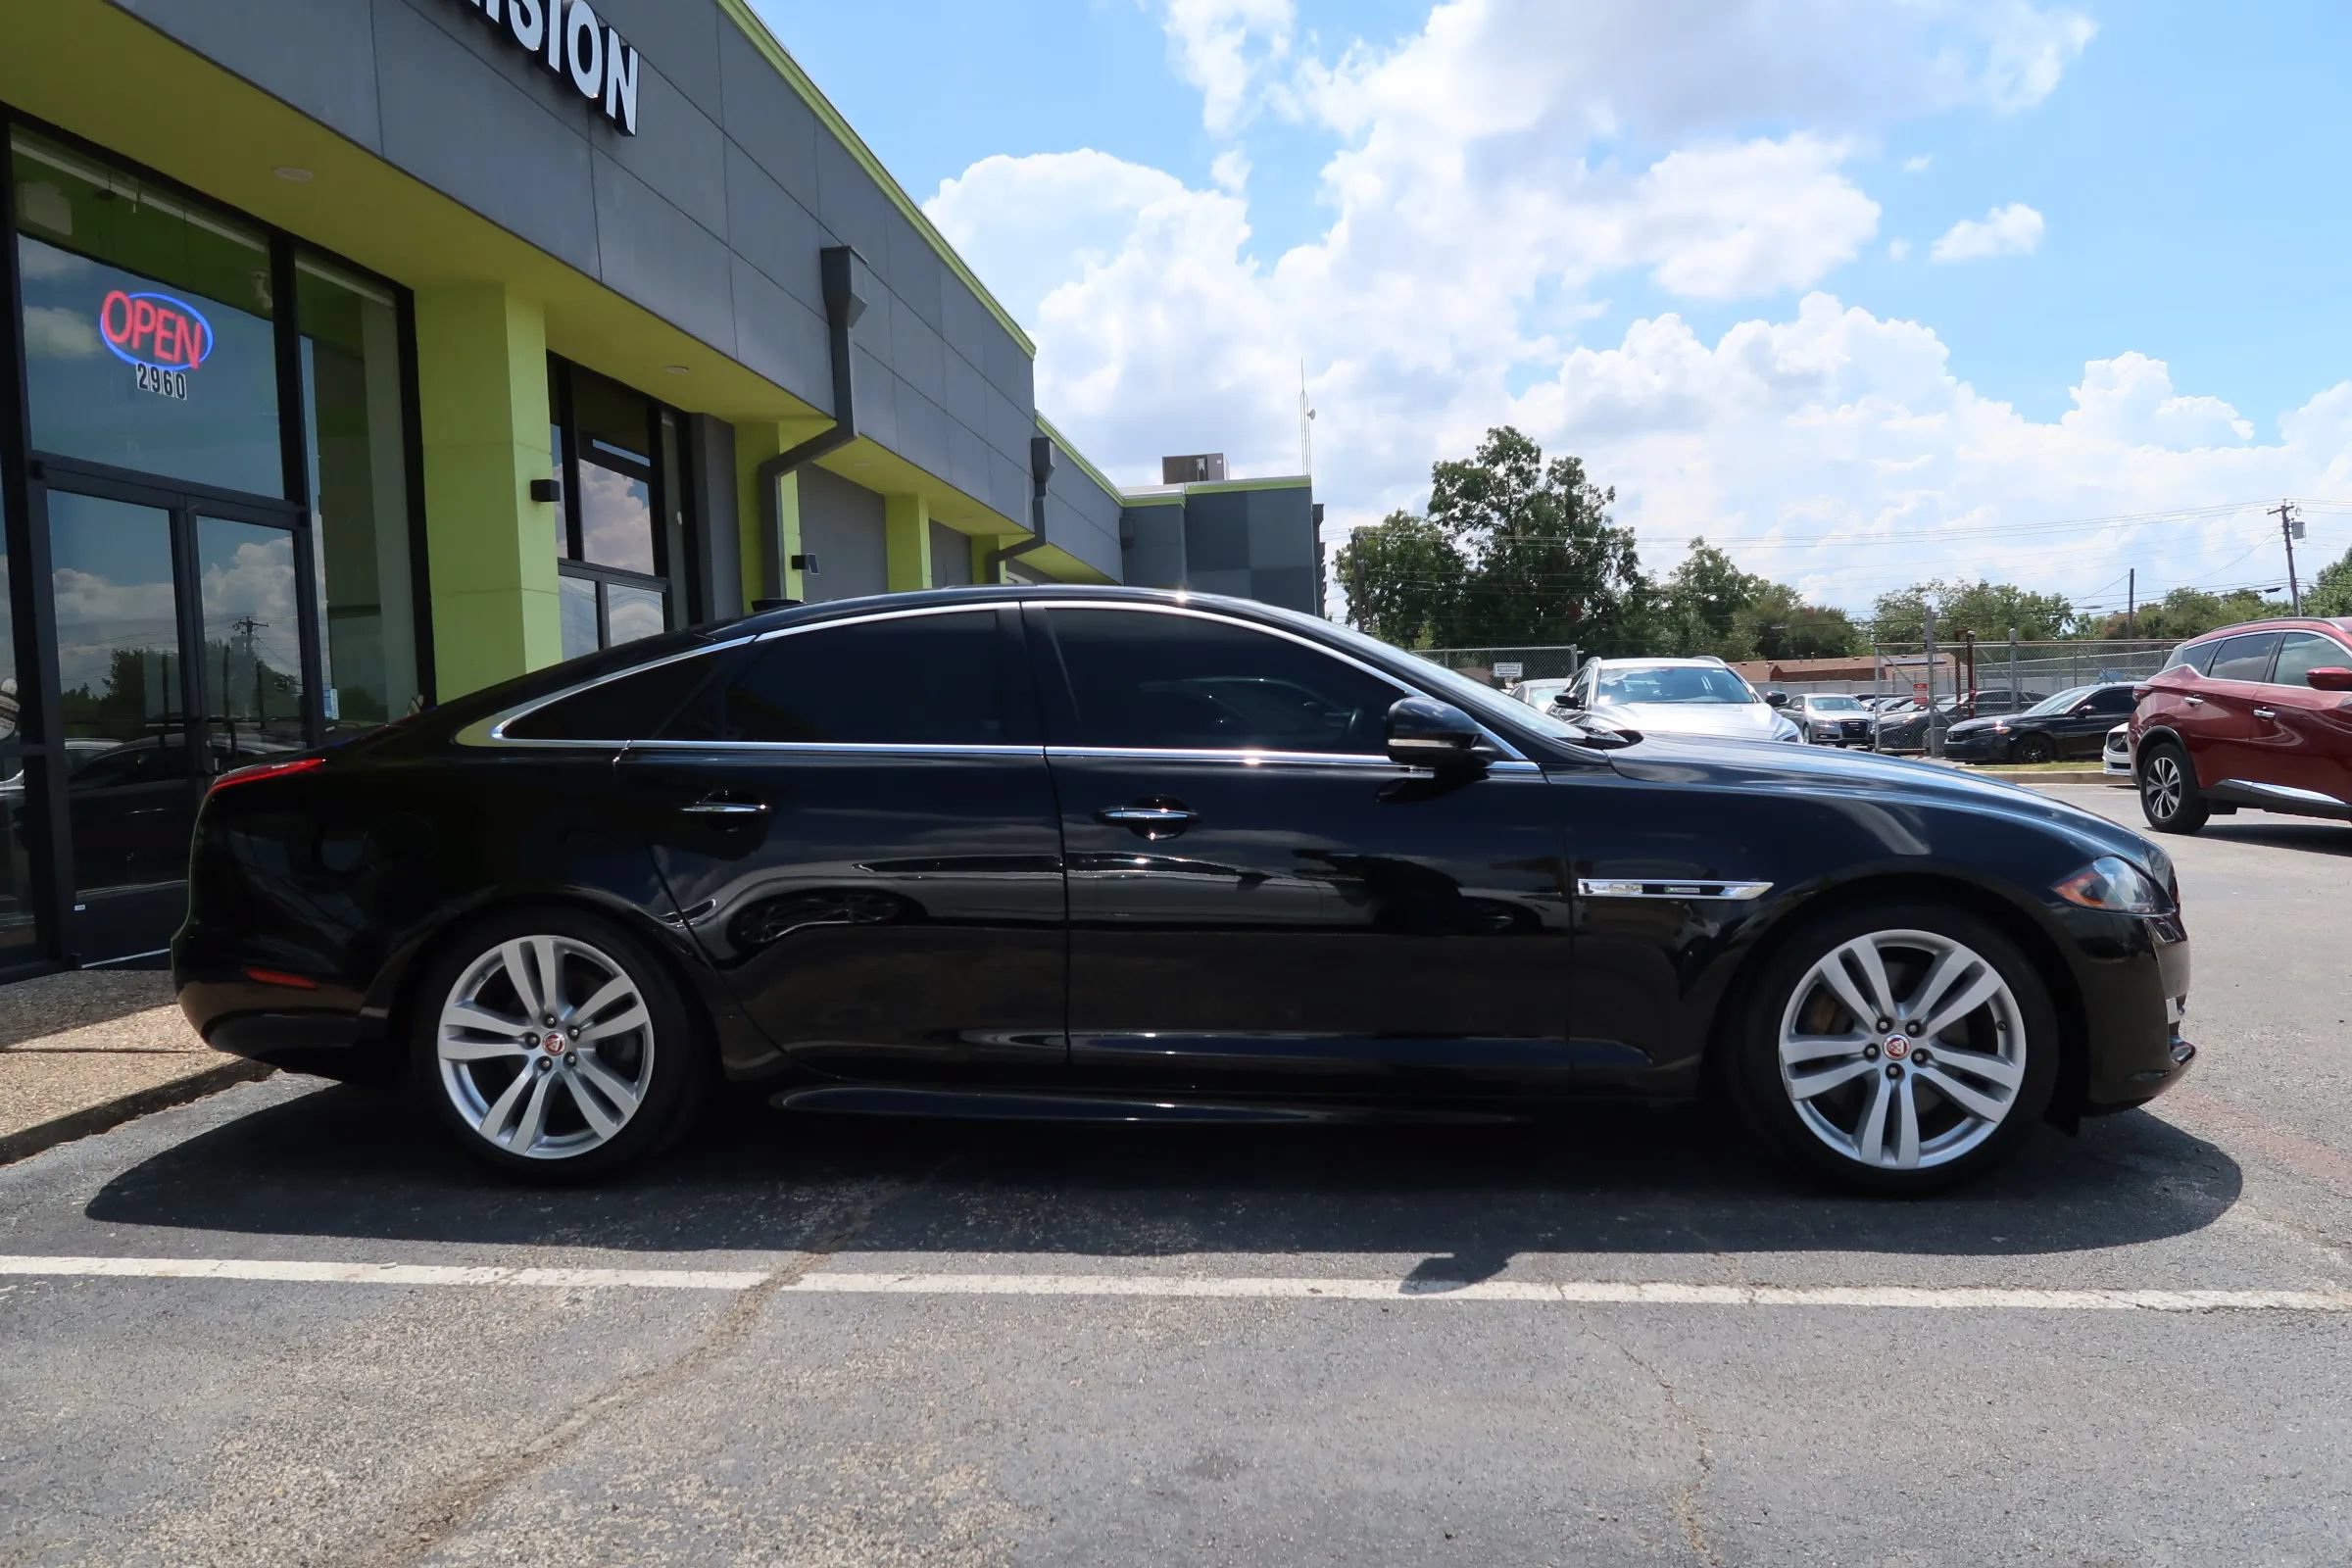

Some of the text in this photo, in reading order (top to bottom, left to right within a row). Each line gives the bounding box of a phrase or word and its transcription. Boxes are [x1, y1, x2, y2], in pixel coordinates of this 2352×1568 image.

[470, 0, 638, 135] SION
[101, 290, 202, 369] OPEN
[137, 364, 186, 400] 2960
